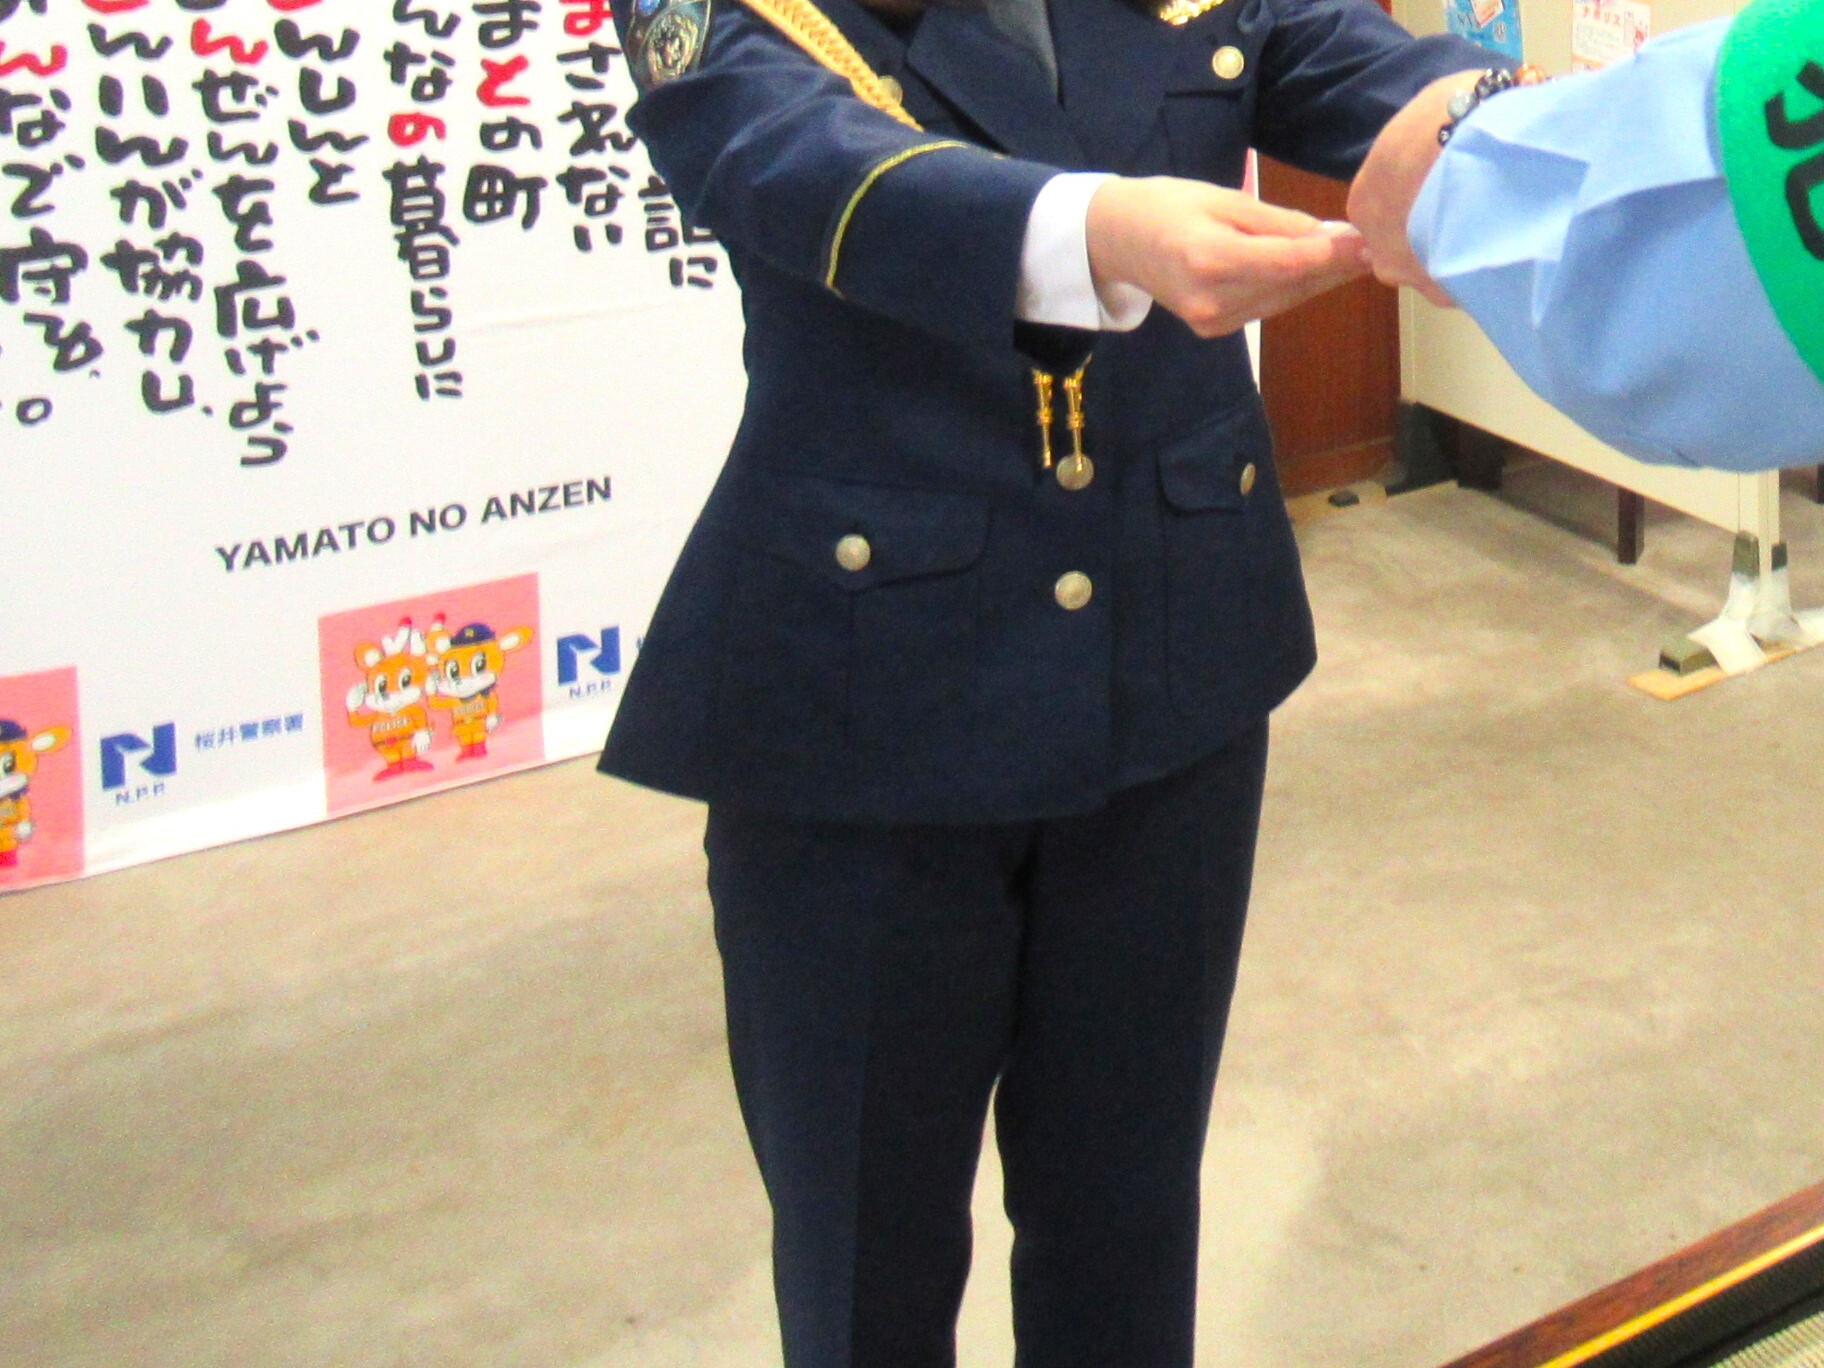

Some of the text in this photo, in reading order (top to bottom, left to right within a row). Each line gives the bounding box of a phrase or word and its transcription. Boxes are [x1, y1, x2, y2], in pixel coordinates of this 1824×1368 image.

[215, 475, 613, 573] YAMATO NO ANZEN
